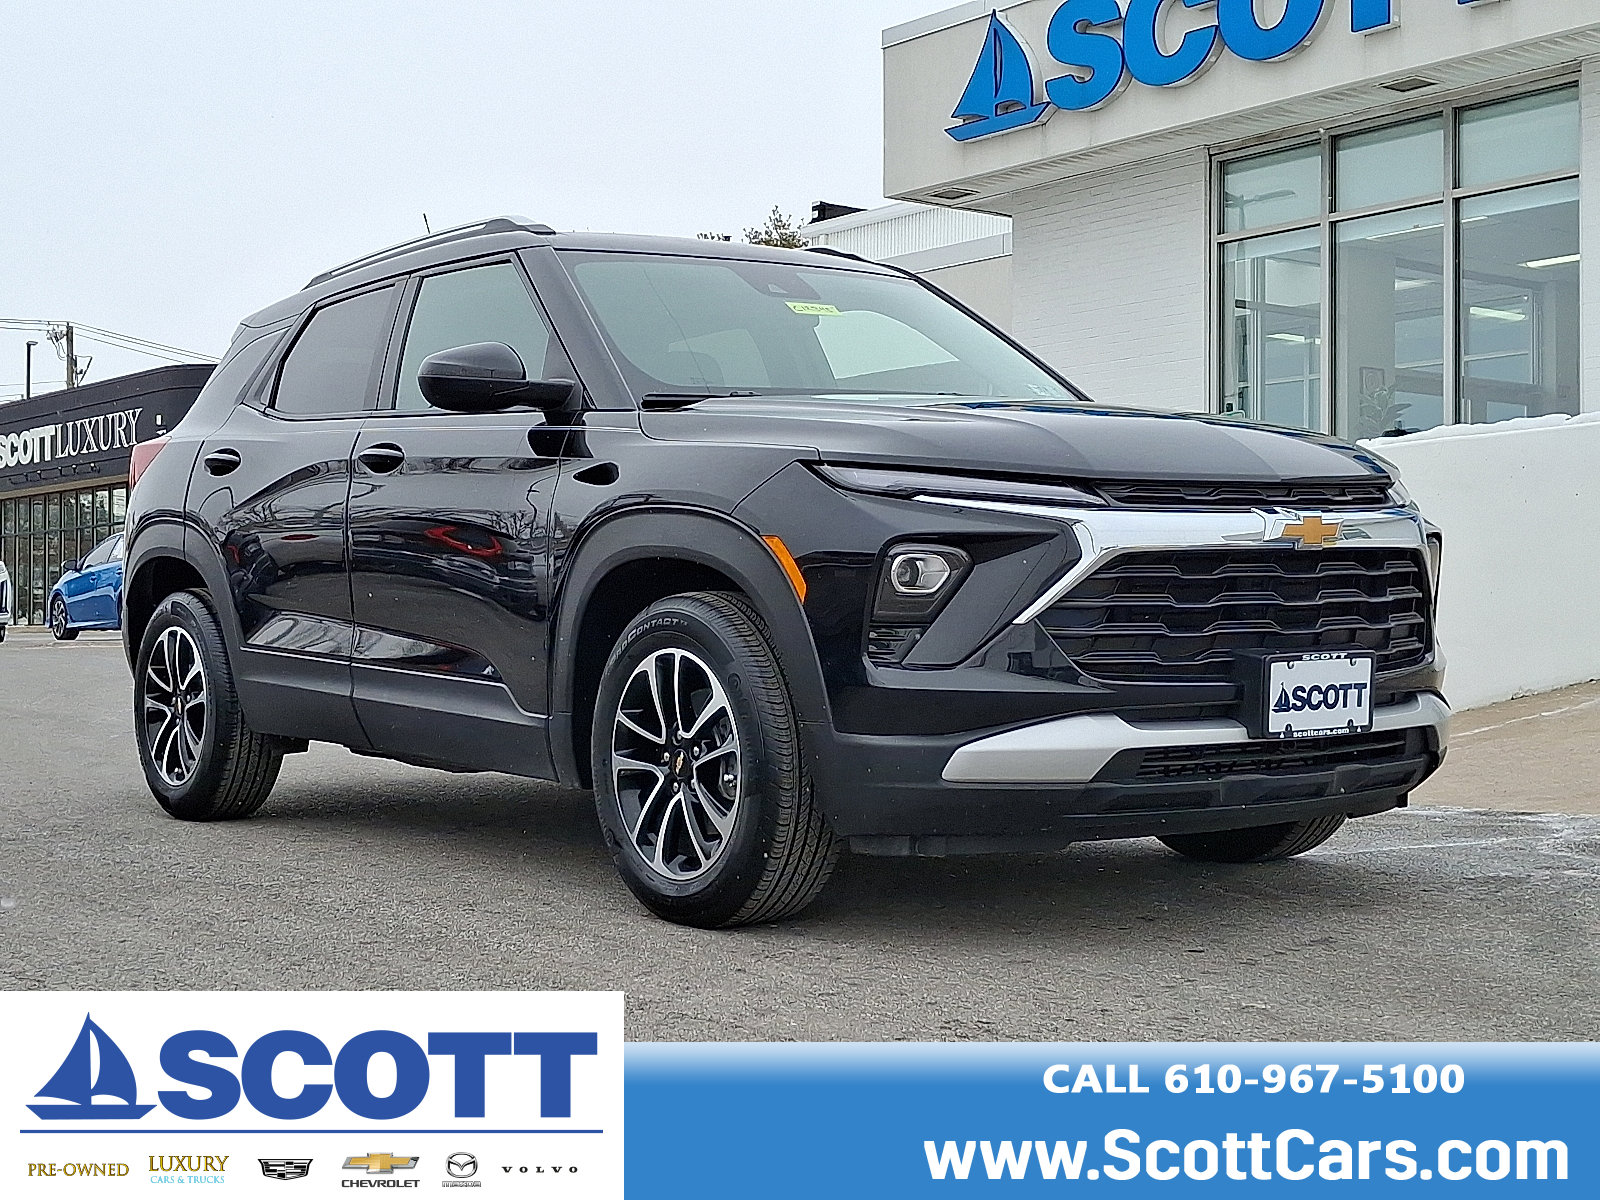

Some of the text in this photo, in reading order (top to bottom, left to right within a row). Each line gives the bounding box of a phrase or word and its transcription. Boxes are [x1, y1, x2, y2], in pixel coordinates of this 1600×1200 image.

[1044, 0, 1505, 112] SCO
[54, 408, 143, 459] LUXURY
[1301, 652, 1348, 661] SCOTT
[1291, 682, 1368, 712] SCOTT
[1292, 727, 1350, 738] scottcars.com
